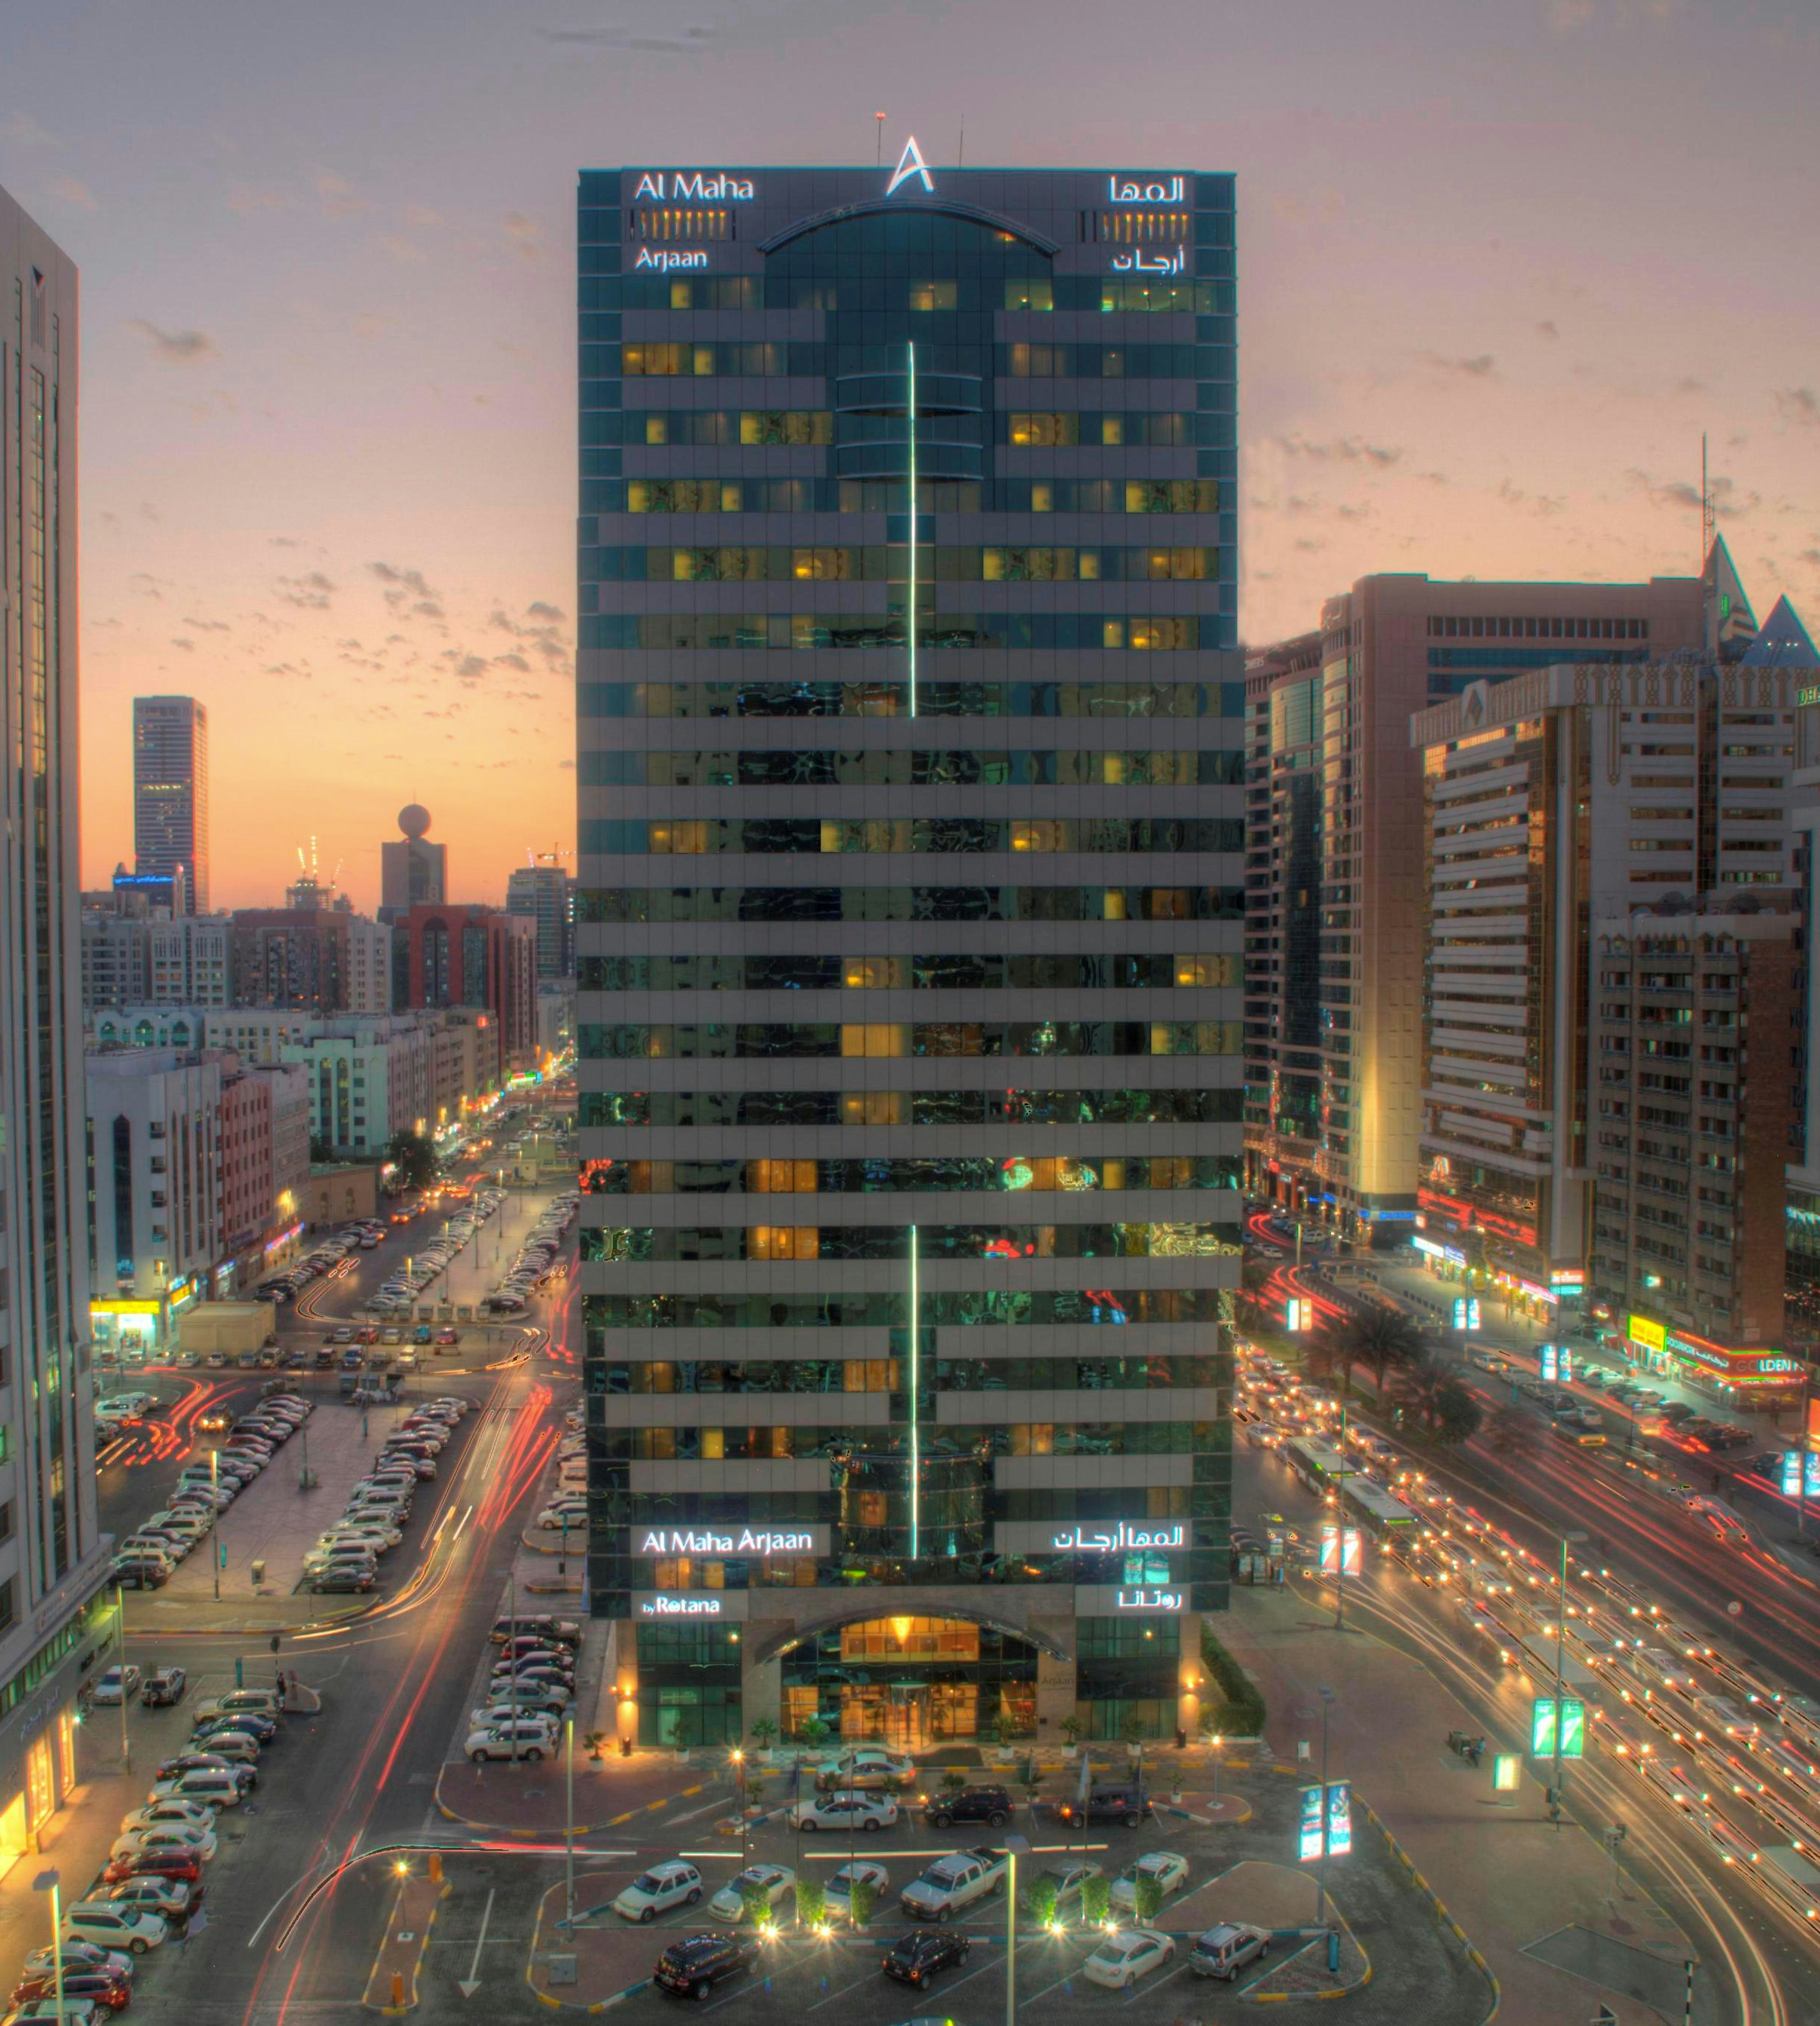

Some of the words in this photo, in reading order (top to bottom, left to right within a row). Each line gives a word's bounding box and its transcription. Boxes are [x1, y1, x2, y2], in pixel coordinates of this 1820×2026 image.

[636, 174, 663, 200] Al
[674, 173, 753, 200] Maha
[1110, 175, 1184, 202] المها
[636, 248, 707, 272] Arjaan
[642, 1532, 667, 1552] Al
[671, 1532, 733, 1552] Maha
[736, 1529, 812, 1554] Arjaan
[1127, 1526, 1184, 1547] المها
[642, 1603, 655, 1615] by
[656, 1596, 721, 1614] Rotana
